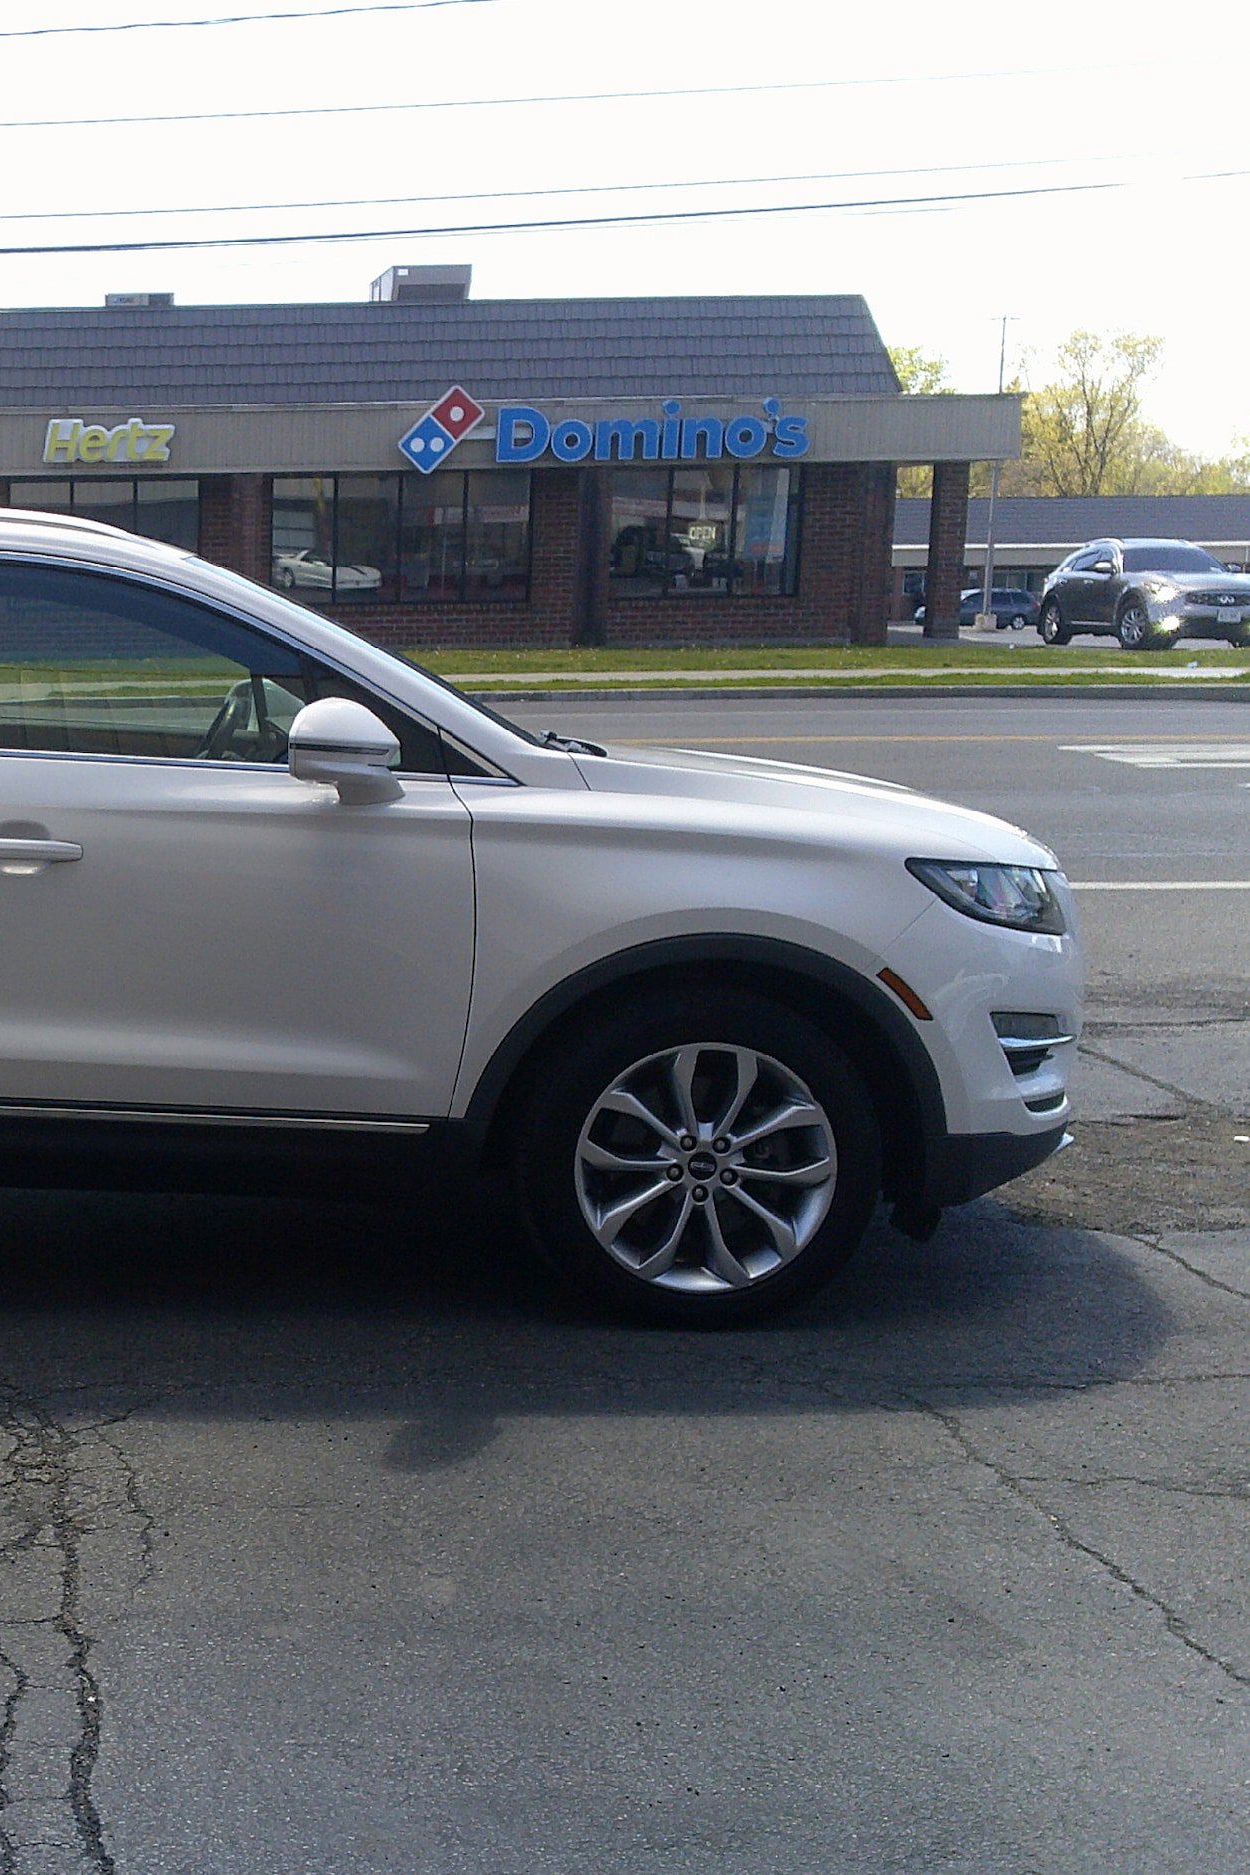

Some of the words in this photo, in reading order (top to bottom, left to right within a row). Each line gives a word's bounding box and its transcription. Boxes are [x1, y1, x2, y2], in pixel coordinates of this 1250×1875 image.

[45, 420, 172, 461] Hertz
[496, 398, 810, 463] Domino's
[689, 526, 716, 540] OPEN
